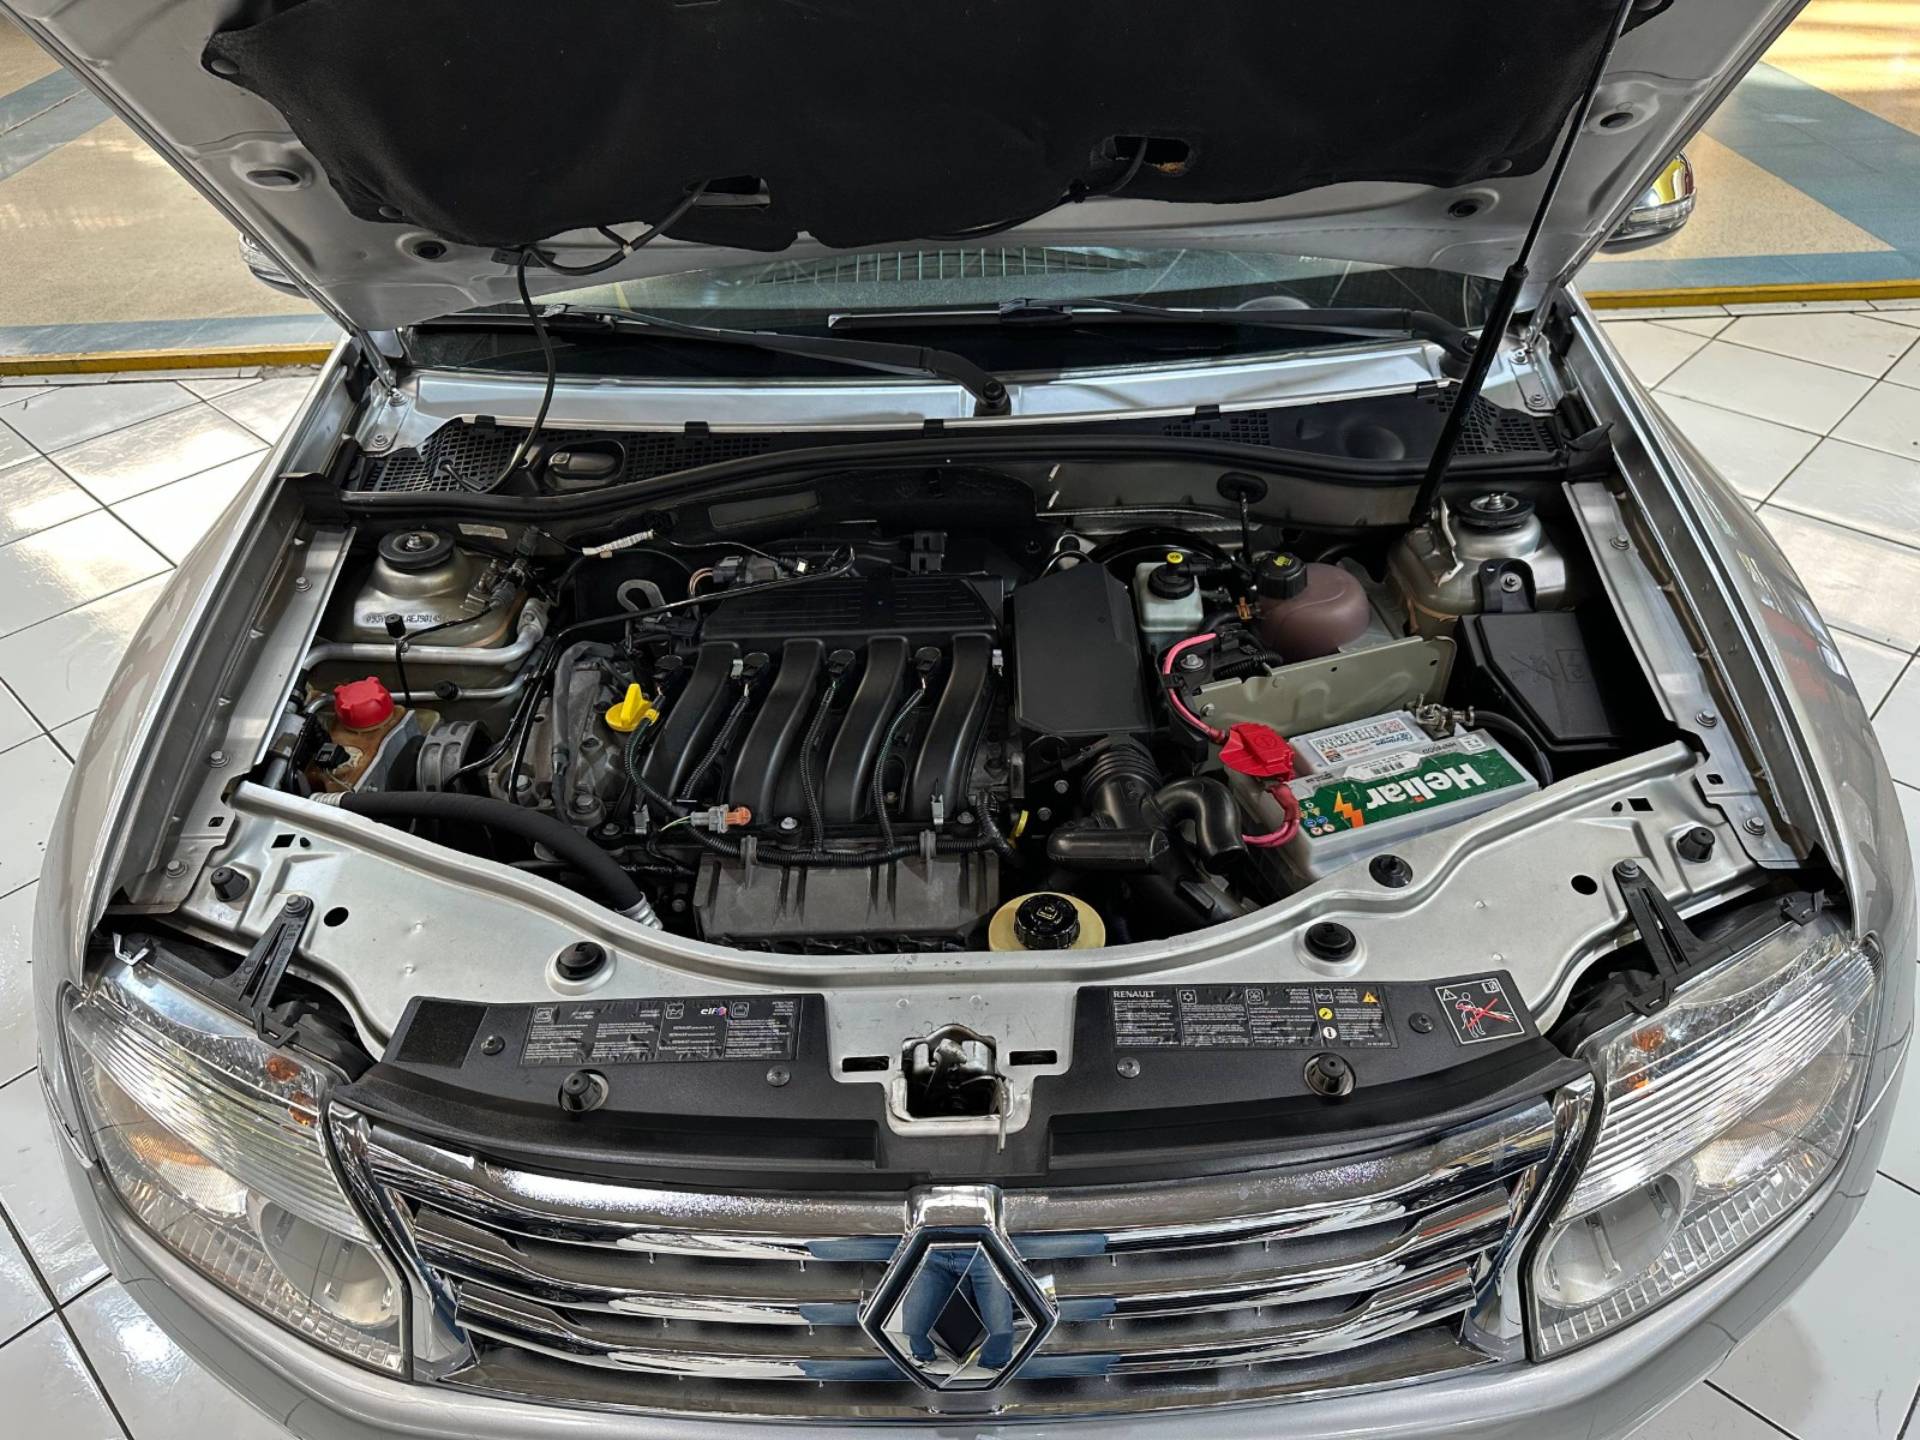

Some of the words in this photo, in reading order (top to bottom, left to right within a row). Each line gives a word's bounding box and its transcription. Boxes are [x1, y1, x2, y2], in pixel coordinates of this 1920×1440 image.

[1366, 763, 1486, 810] Heliar
[1113, 990, 1155, 998] RENAULT
[700, 1007, 717, 1015] elf
